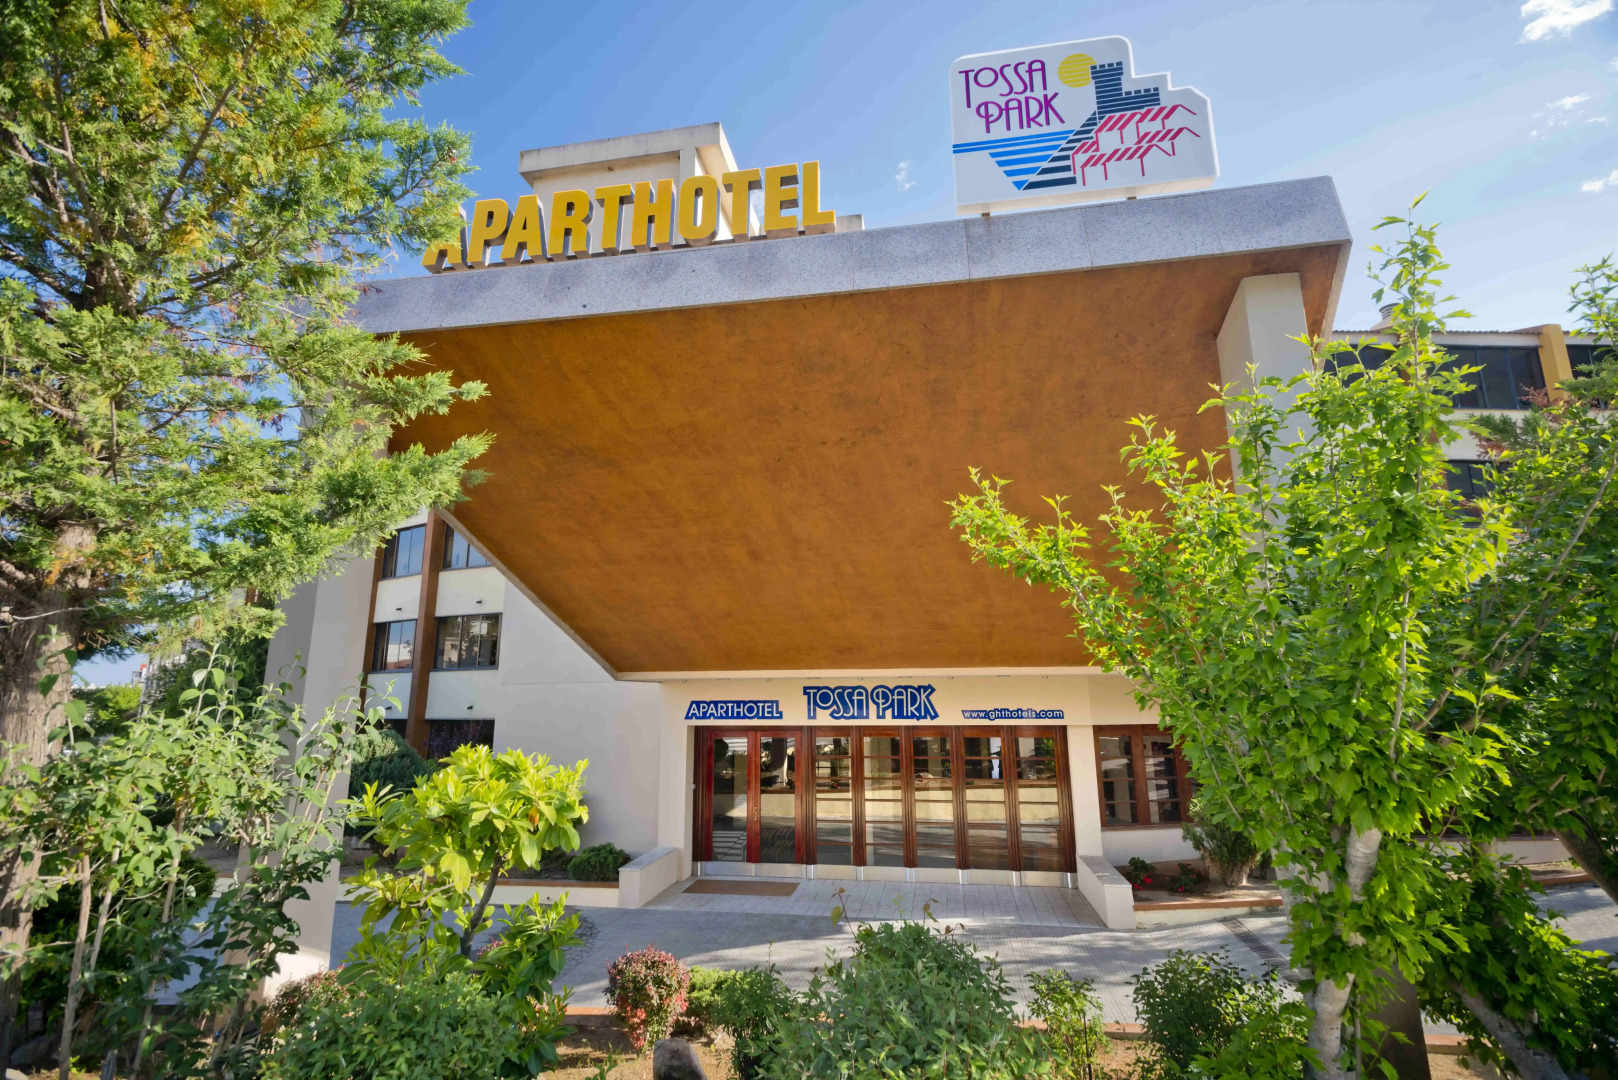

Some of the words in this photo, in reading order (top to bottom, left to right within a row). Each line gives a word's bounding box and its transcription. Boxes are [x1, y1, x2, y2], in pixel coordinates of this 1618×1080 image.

[958, 59, 1048, 109] TOSSA
[975, 92, 1066, 134] PARK
[687, 702, 781, 718] APARTHOTEL
[805, 688, 867, 717] TOSSA
[872, 687, 935, 717] PARK
[963, 709, 1064, 720] www.ghthotels.com
